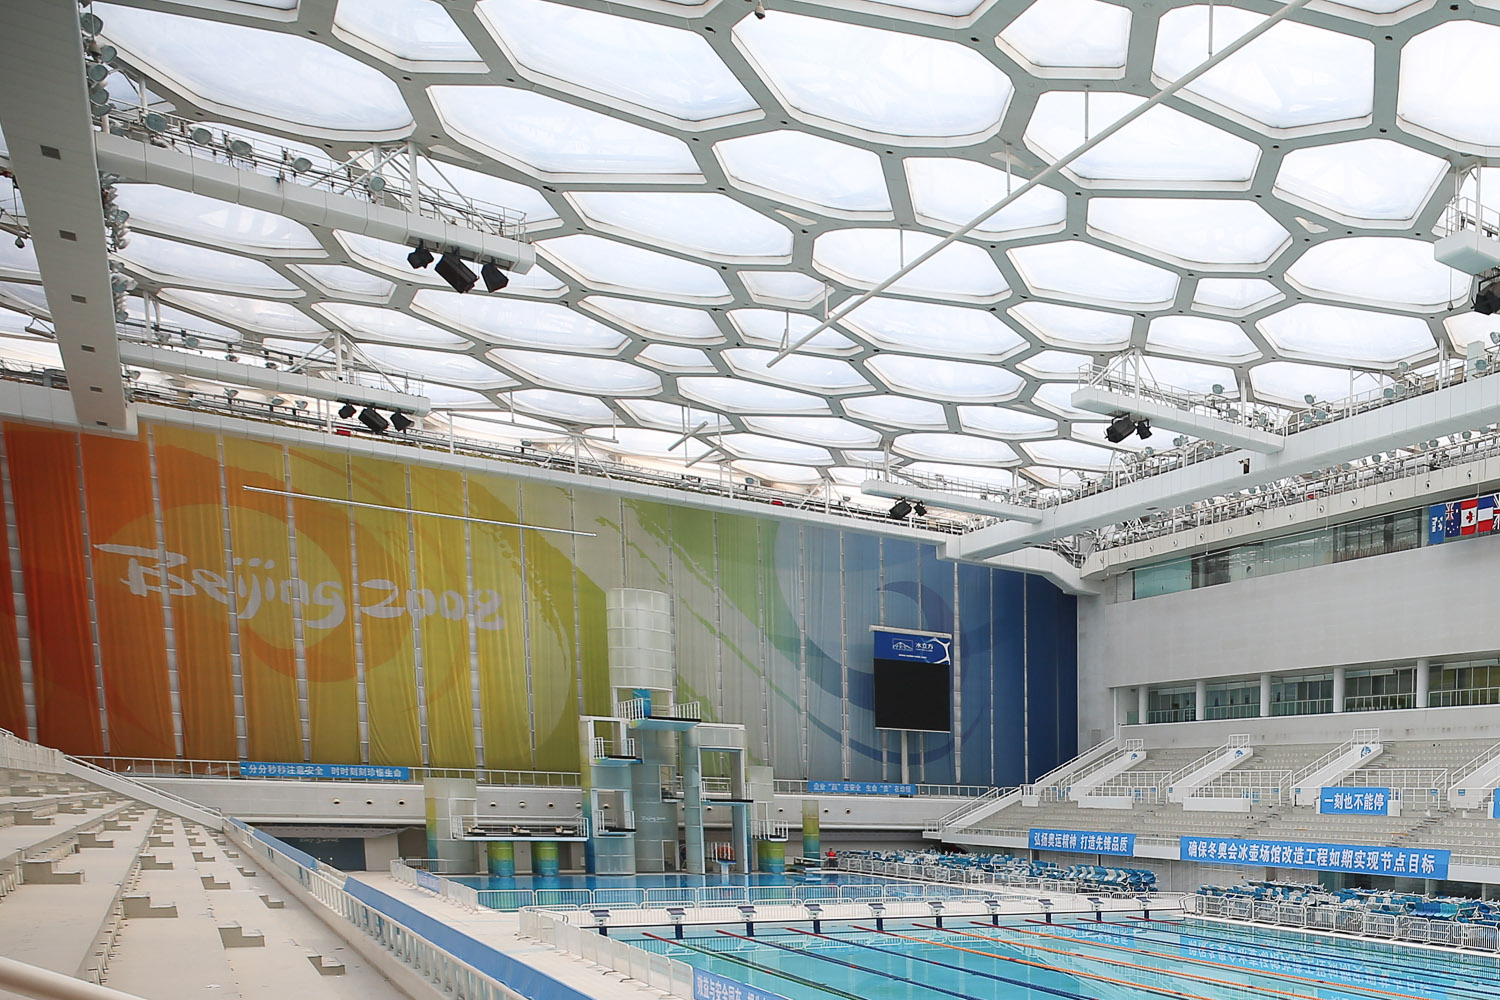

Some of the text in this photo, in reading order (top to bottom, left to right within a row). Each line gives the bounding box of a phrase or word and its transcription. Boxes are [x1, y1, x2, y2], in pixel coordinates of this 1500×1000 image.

[93, 543, 505, 631] Beijing 2008
[1324, 793, 1385, 811] 一刻也不能停
[1034, 832, 1128, 852] 弘扬奥运精神 打造先锋品质
[1188, 840, 1435, 874] 确保冬奥会冰壶场馆改造工程如期实现节点目标
